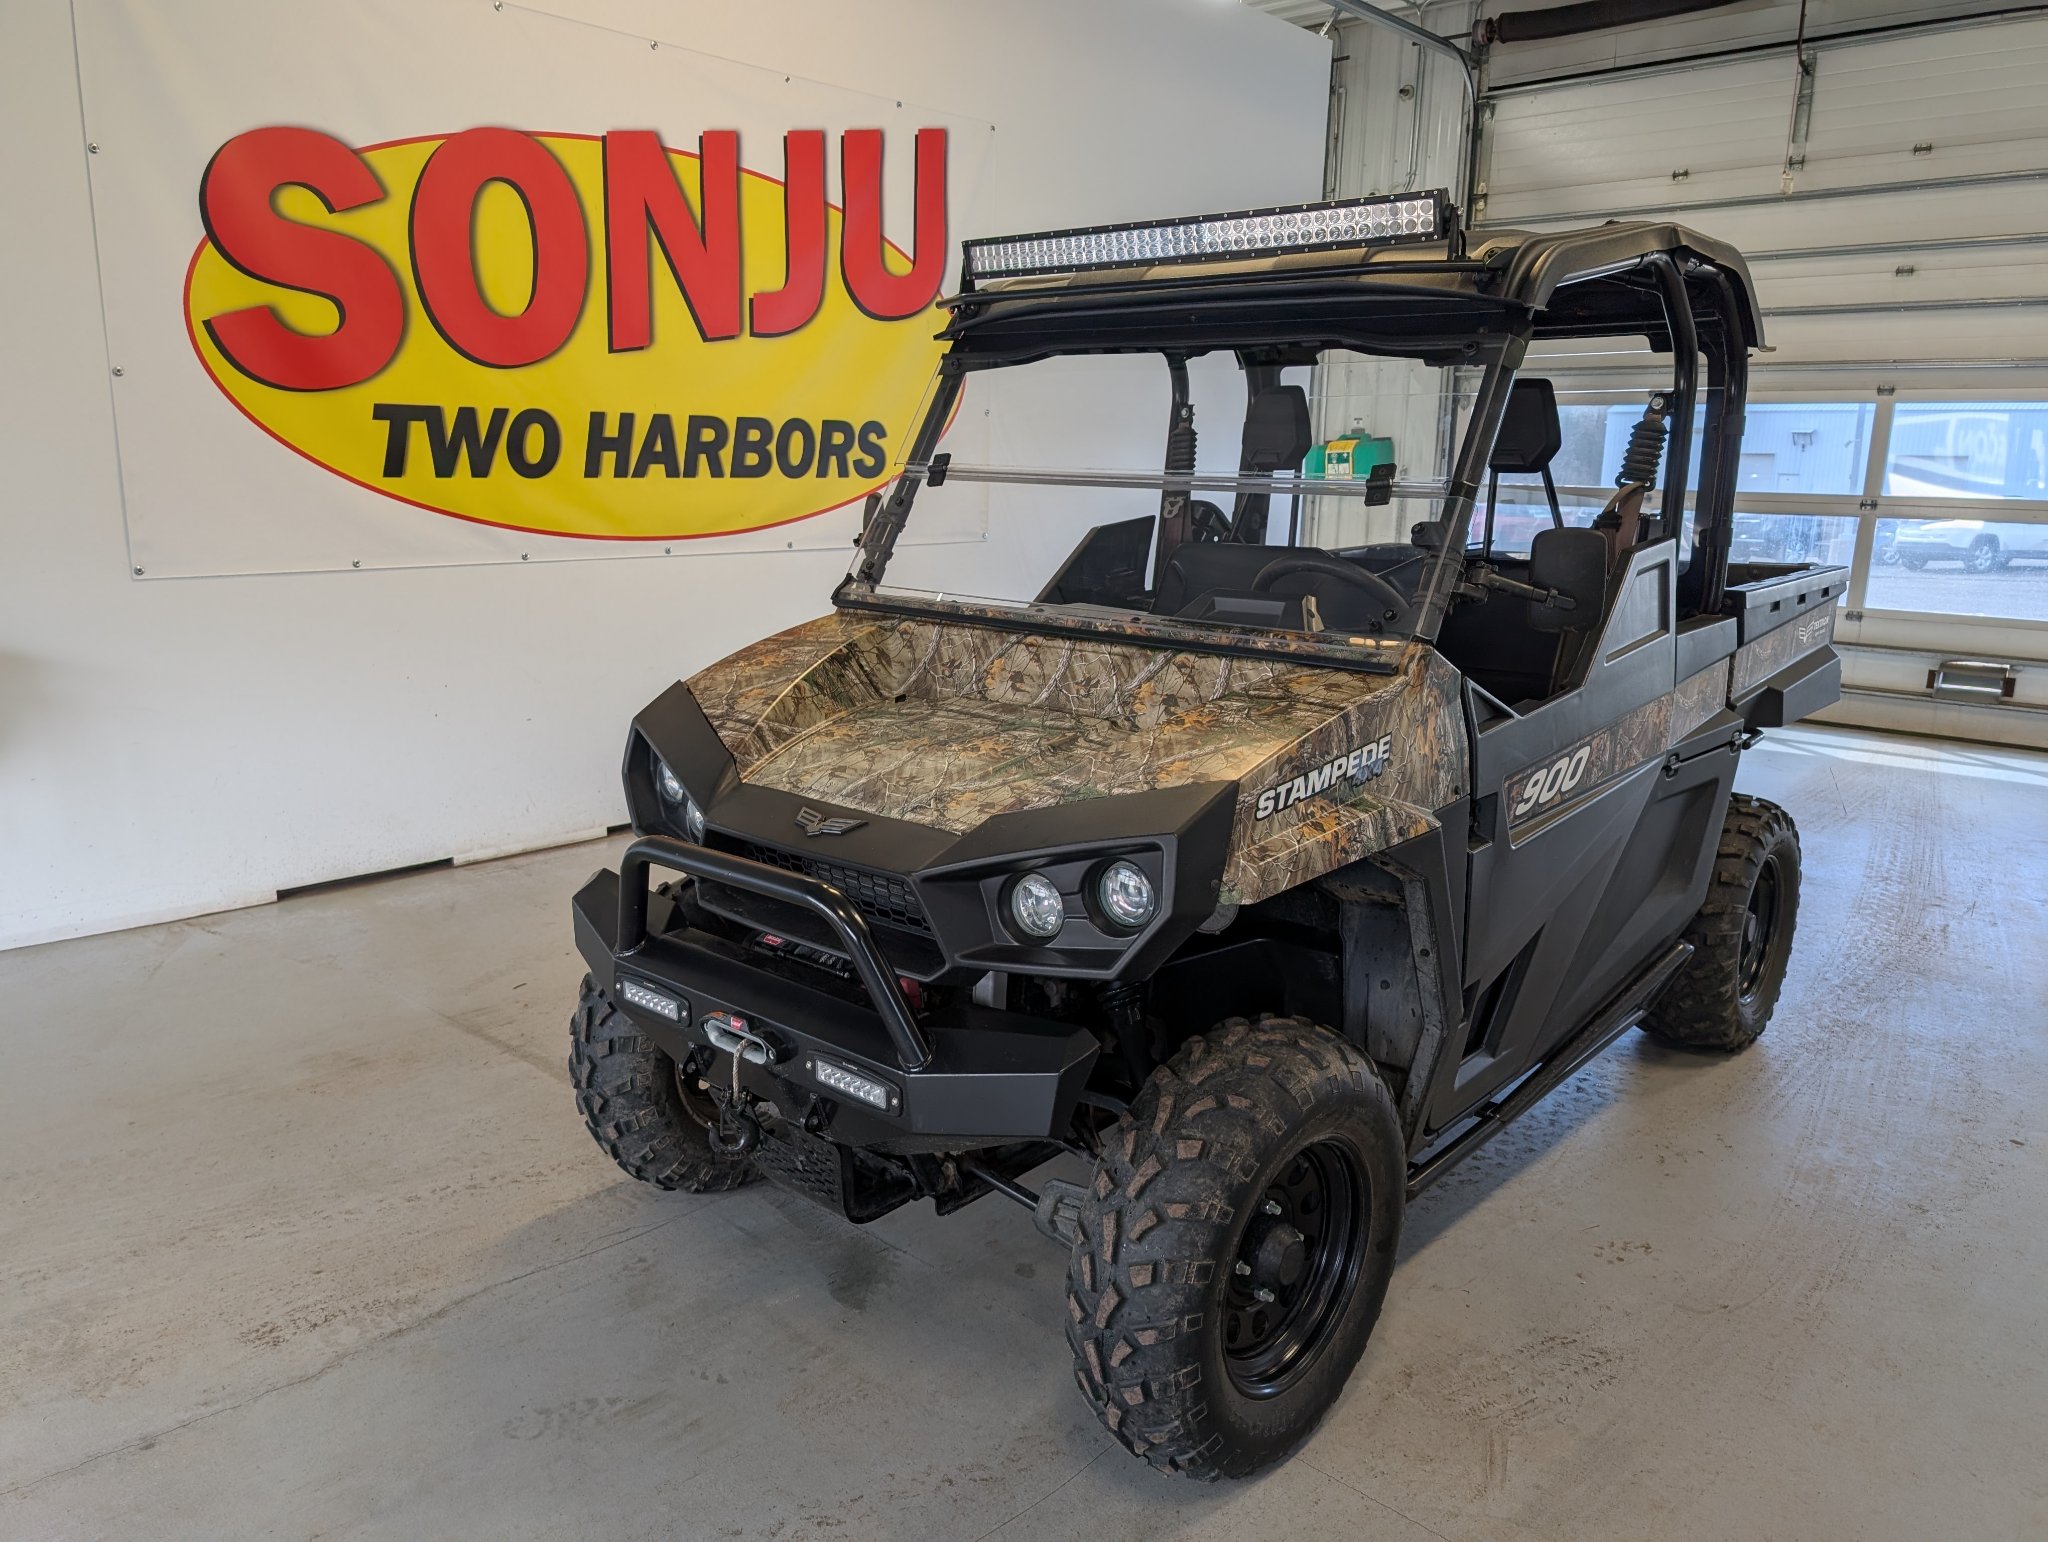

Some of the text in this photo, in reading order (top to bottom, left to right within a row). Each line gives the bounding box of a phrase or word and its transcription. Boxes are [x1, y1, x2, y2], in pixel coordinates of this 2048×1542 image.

[200, 126, 948, 391] SONJU
[372, 403, 887, 480] TWO HARBORS
[1255, 734, 1392, 820] STAMPEDE
[1515, 745, 1591, 816] 900
